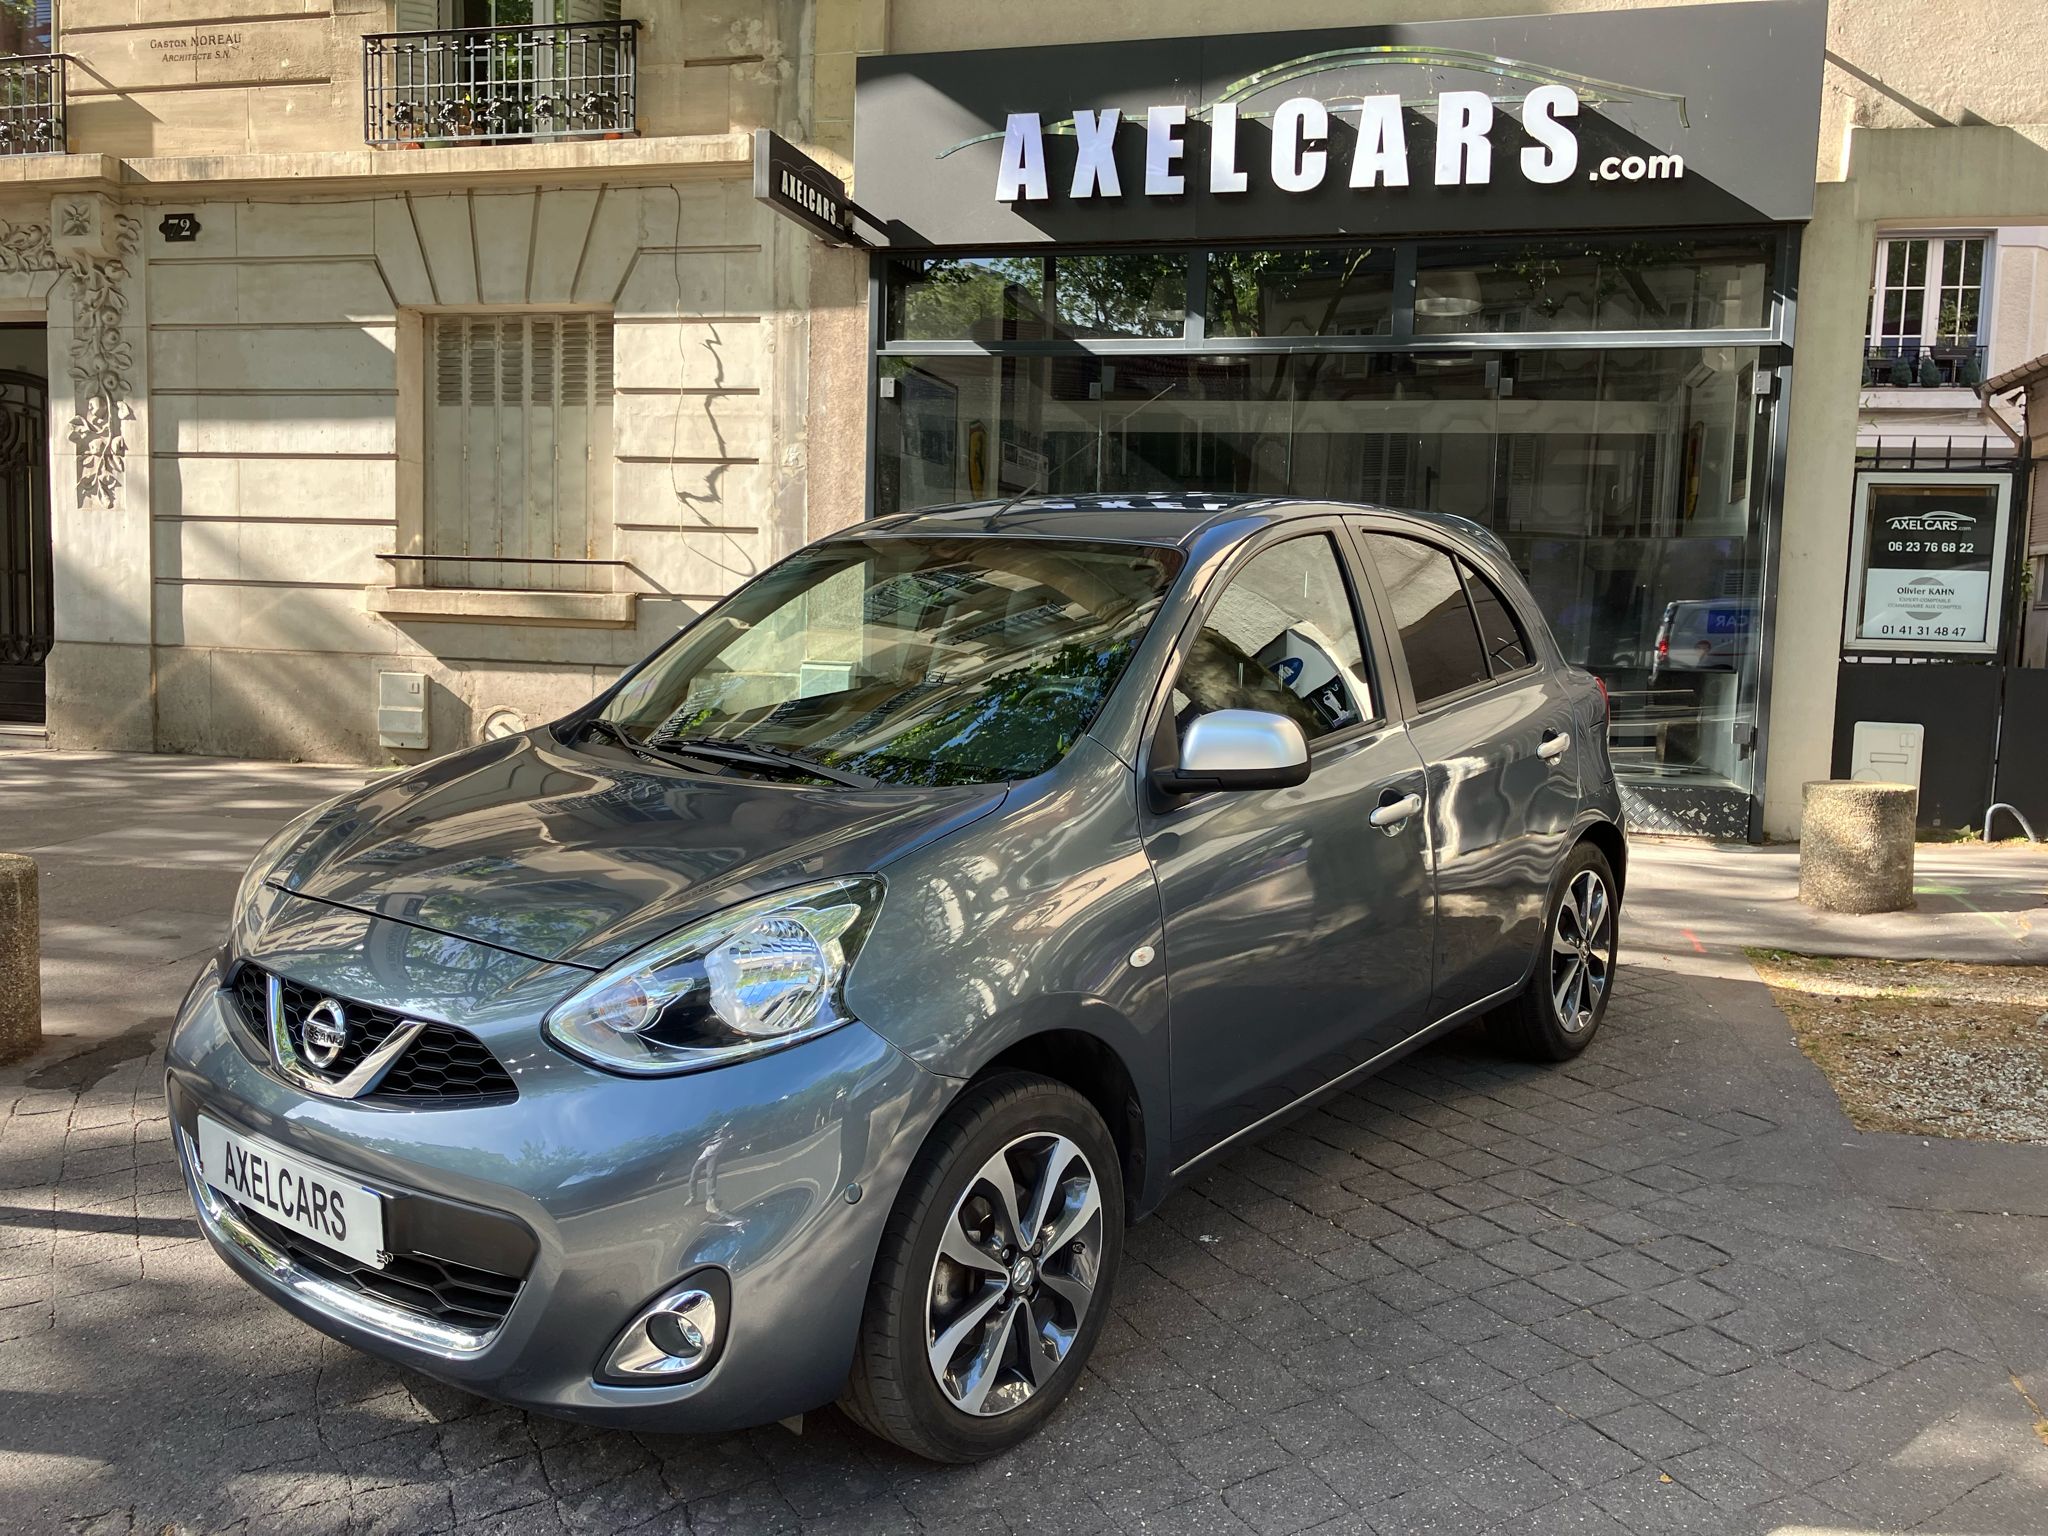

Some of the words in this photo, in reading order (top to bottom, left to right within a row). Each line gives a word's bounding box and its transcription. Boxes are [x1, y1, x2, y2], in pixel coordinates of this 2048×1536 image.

[168, 218, 191, 236] 72
[1888, 541, 1903, 551] 06
[1905, 541, 1921, 552] 23
[1923, 542, 1939, 552] 76
[1941, 542, 1956, 553] 68
[1959, 543, 1974, 553] 22
[1897, 587, 1926, 595] Olivier
[1928, 588, 1955, 596] KAHN
[1881, 624, 1895, 635] 01
[1899, 625, 1912, 635] 41
[1917, 626, 1930, 636] 31
[1934, 626, 1949, 637] 48
[1952, 627, 1967, 637] 47
[224, 1140, 347, 1242] AXELCARS
